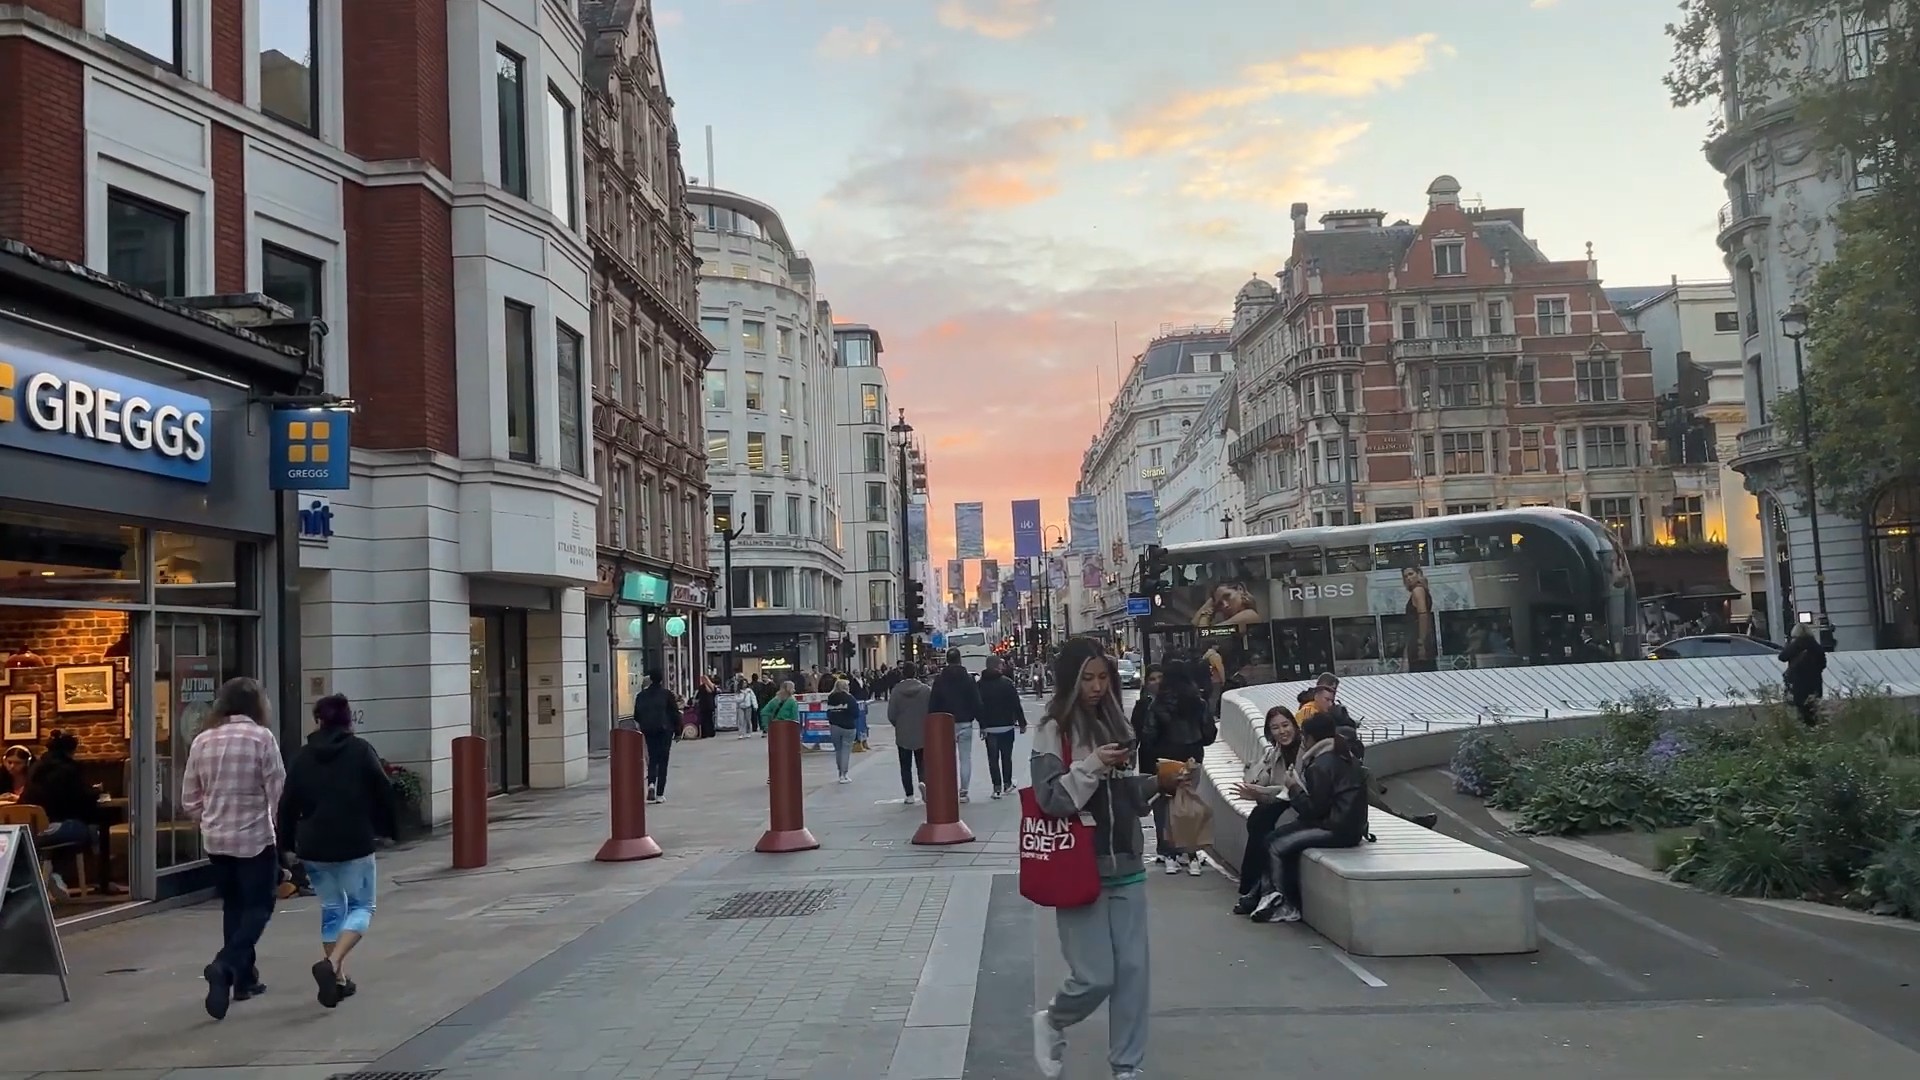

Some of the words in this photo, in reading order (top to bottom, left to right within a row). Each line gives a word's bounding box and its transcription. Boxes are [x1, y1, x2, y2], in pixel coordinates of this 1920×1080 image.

[26, 372, 206, 461] GREGGS
[288, 469, 329, 479] GREGGS
[1141, 466, 1166, 479] Strand
[1289, 583, 1354, 601] REISS
[1201, 629, 1209, 637] 59
